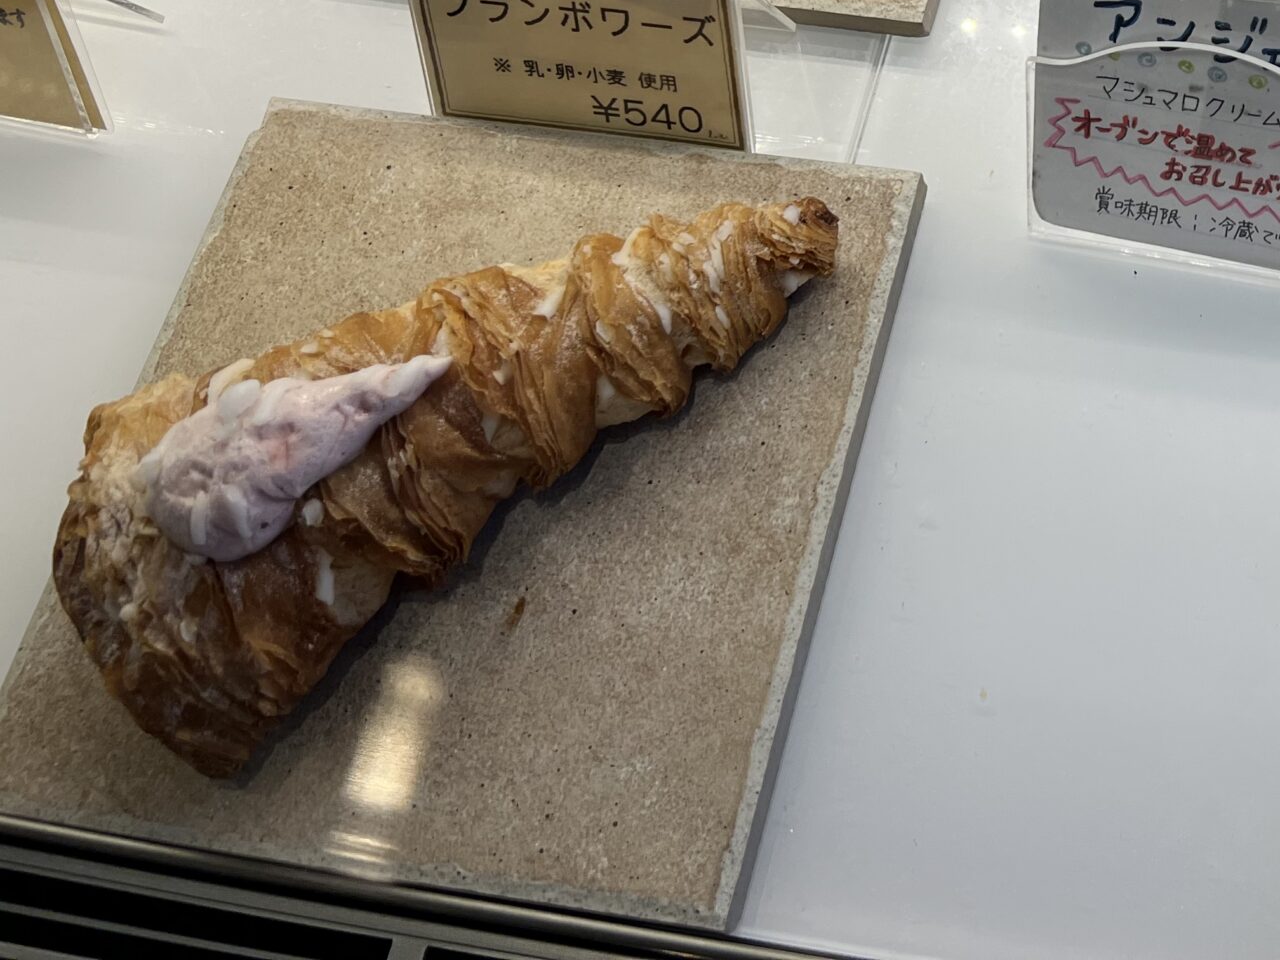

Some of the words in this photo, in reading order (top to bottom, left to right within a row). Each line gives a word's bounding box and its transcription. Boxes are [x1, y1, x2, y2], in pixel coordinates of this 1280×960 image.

[590, 95, 703, 133] ¥540
[1070, 109, 1258, 166] オーブンで温めて
